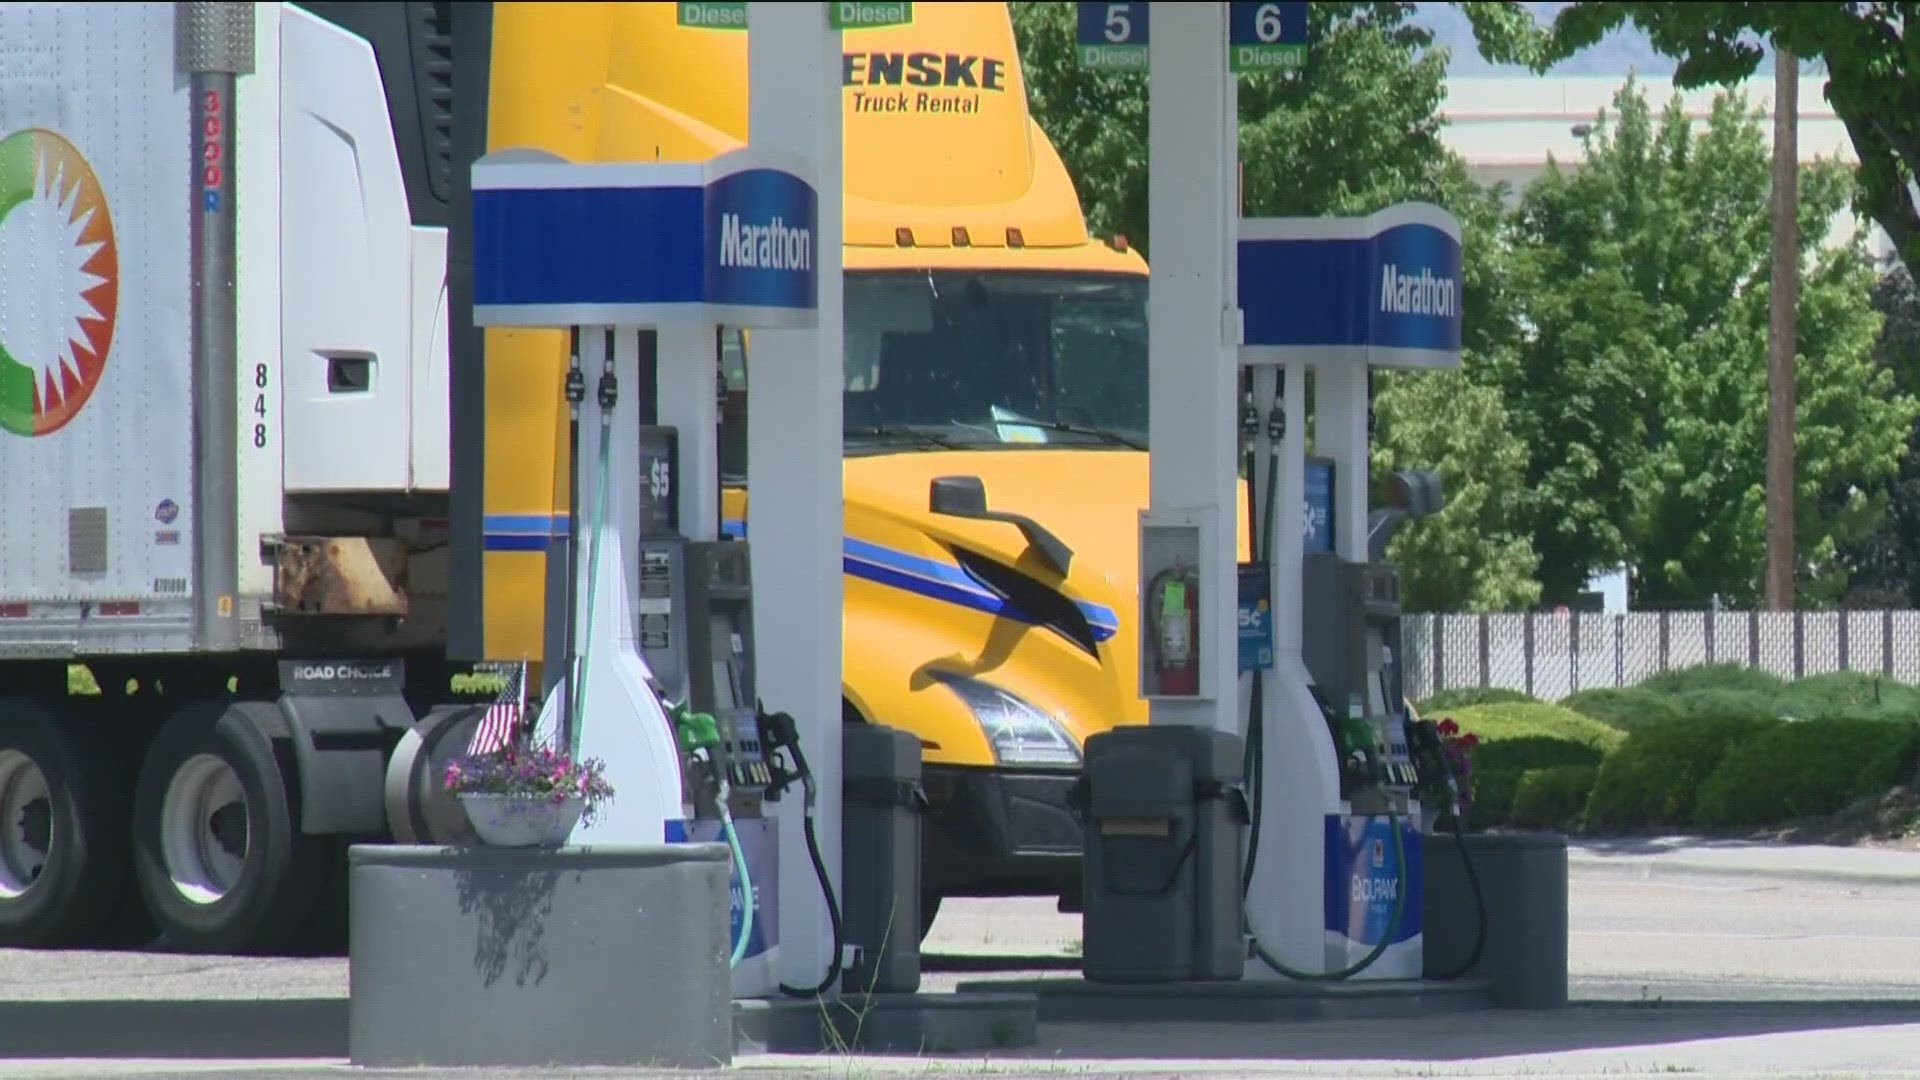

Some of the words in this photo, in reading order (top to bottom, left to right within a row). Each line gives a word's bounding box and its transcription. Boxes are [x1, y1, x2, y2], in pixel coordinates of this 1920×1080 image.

[839, 3, 905, 23] Diesel
[1104, 4, 1131, 43] 5
[1255, 4, 1282, 43] 6
[842, 51, 1005, 92] ENSKE
[1085, 48, 1149, 66] Diesel
[1239, 48, 1301, 67] Diesel
[854, 92, 908, 113] Truck
[916, 91, 979, 114] Rental
[719, 212, 811, 272] Marathon
[1380, 263, 1455, 318] Marathon
[294, 665, 335, 680] ROAD
